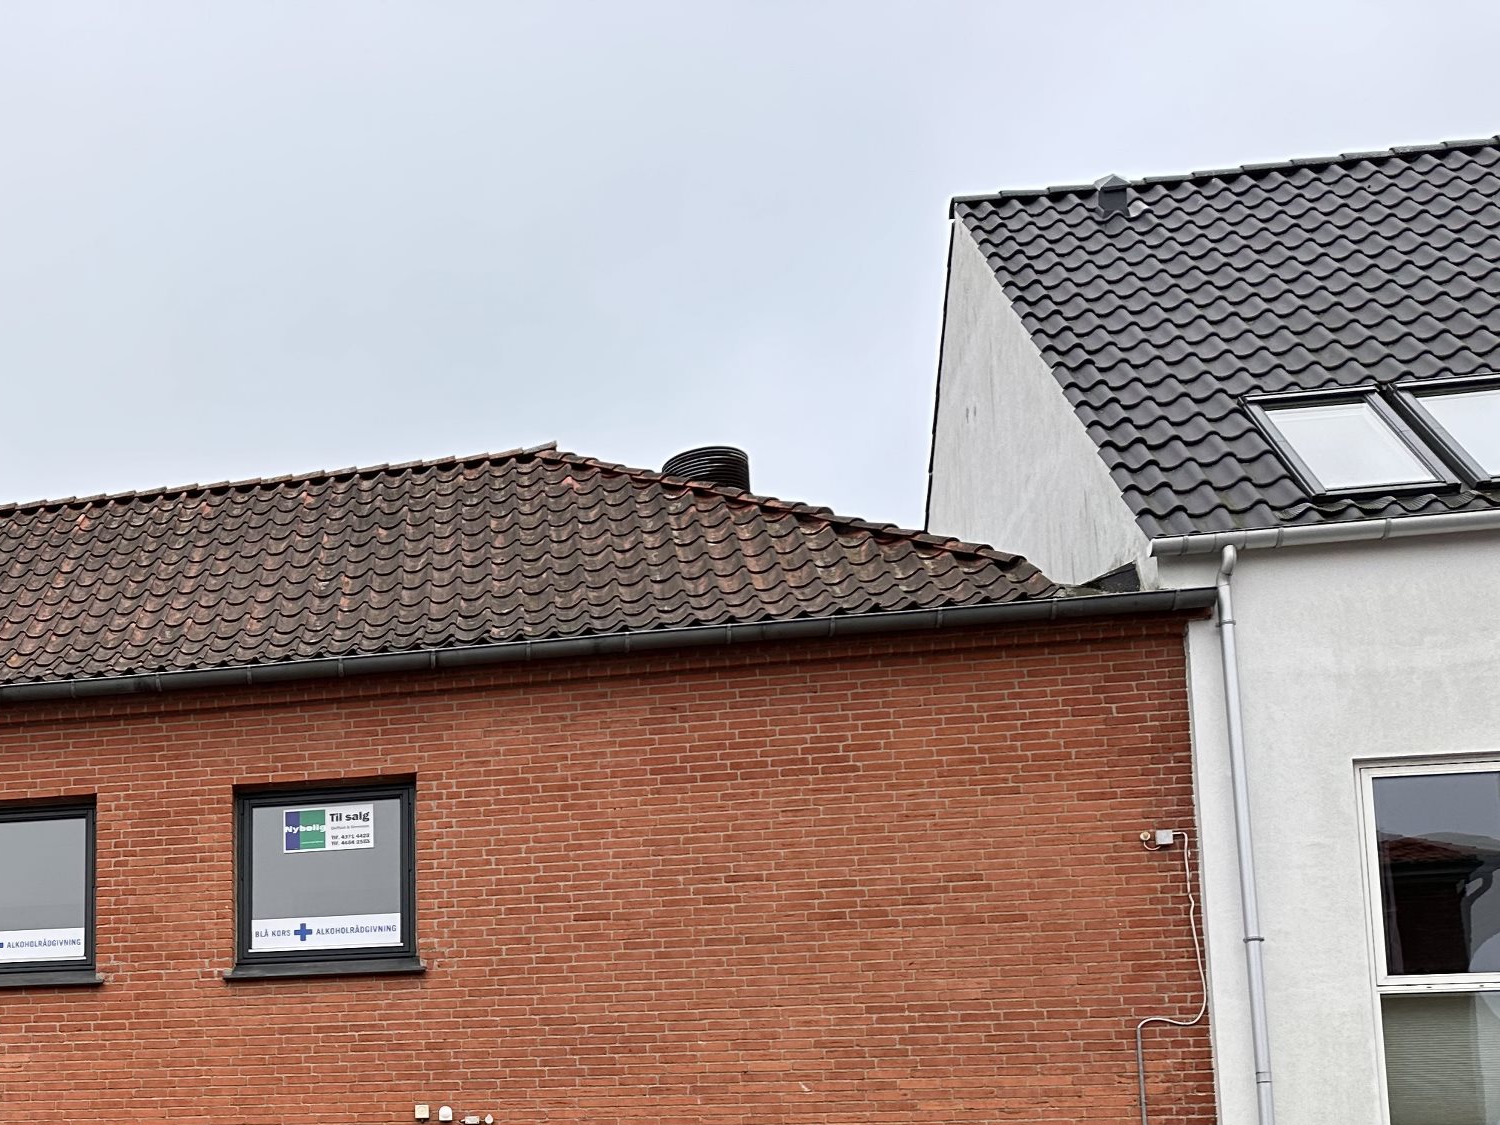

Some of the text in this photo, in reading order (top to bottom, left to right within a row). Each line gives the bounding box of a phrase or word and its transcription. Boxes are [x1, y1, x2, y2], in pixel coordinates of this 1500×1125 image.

[329, 811, 370, 822] Til salg
[285, 824, 327, 833] Nybolig
[316, 925, 397, 935] ALKOHOLRÅDGIVNING
[7, 939, 81, 949] ALKOHOLRÅDGIVNING
